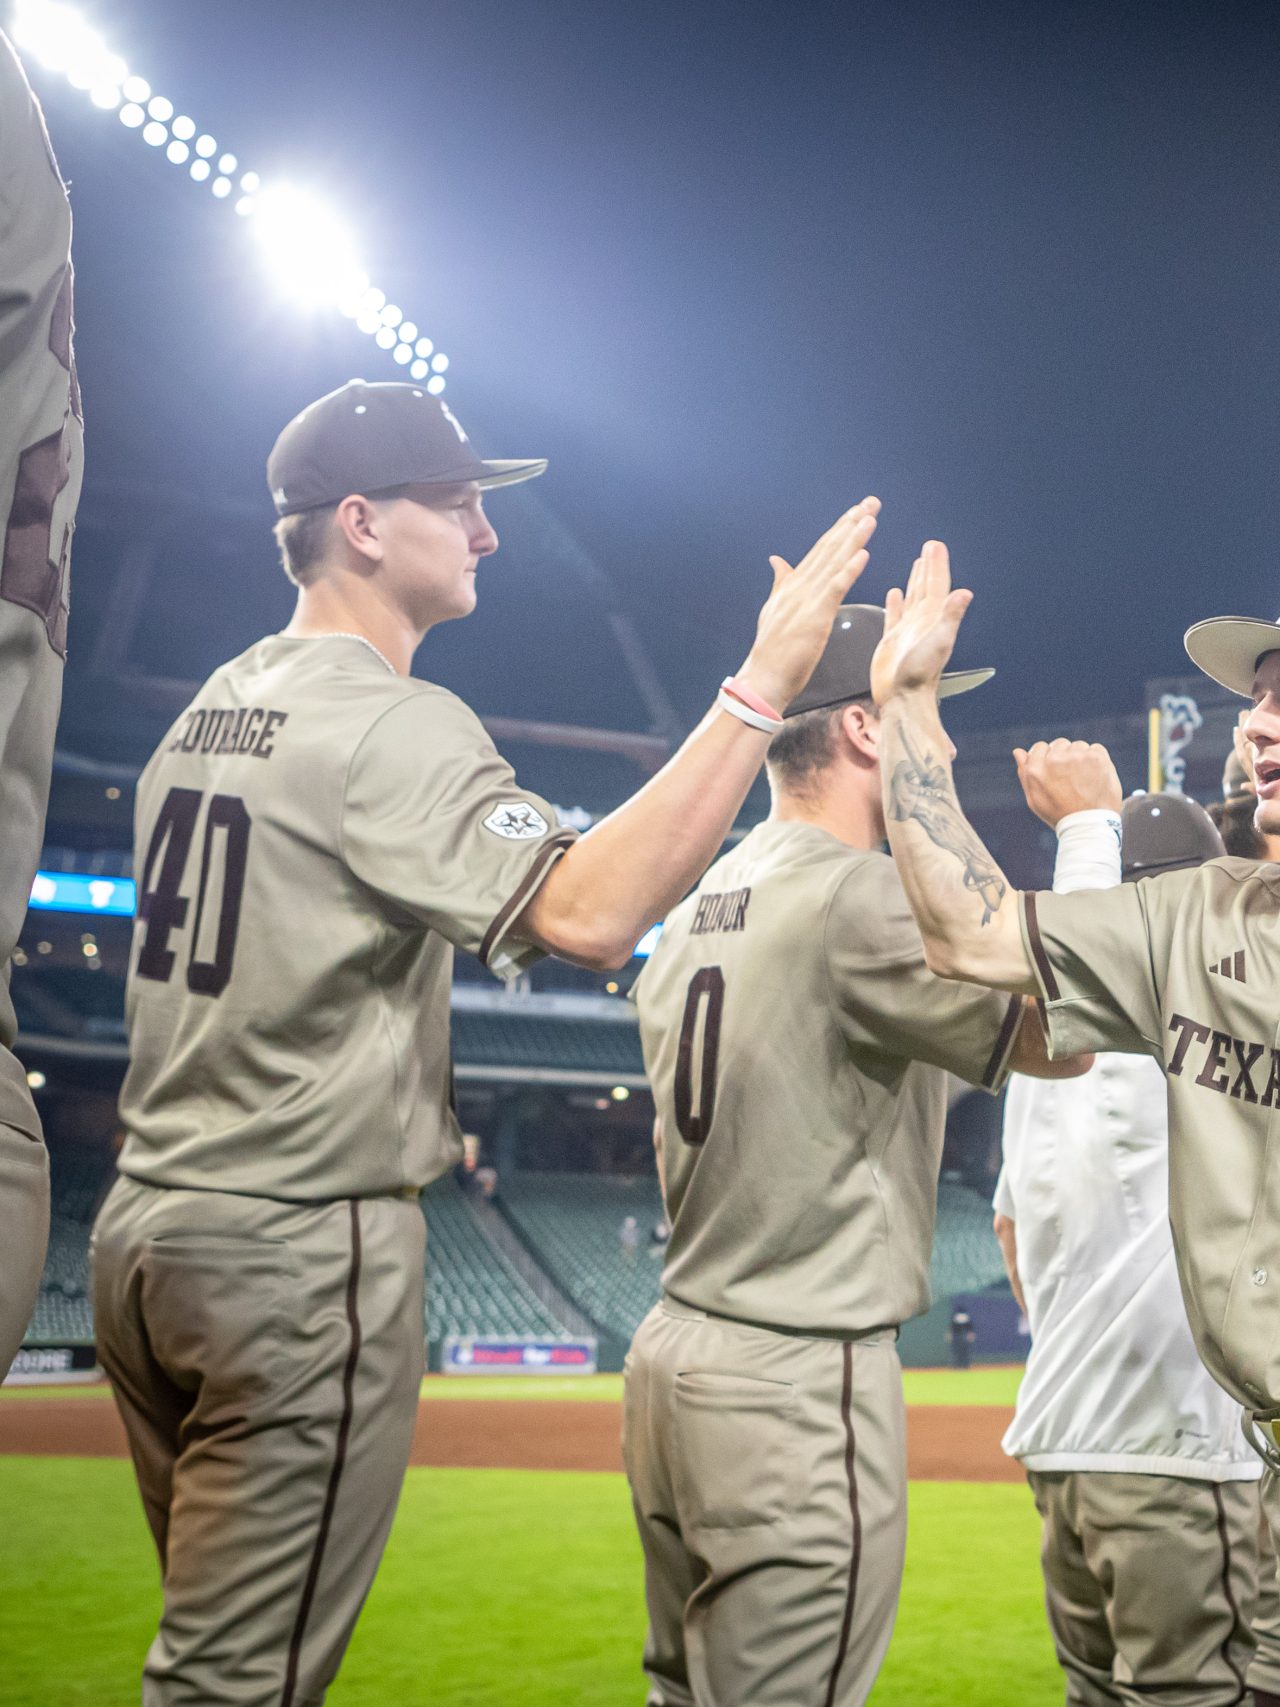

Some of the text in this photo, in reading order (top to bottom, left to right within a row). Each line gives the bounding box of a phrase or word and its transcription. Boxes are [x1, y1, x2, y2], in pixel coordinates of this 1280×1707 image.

[136, 786, 252, 998] 40
[690, 887, 751, 935] HONOR
[674, 965, 726, 1147] 0
